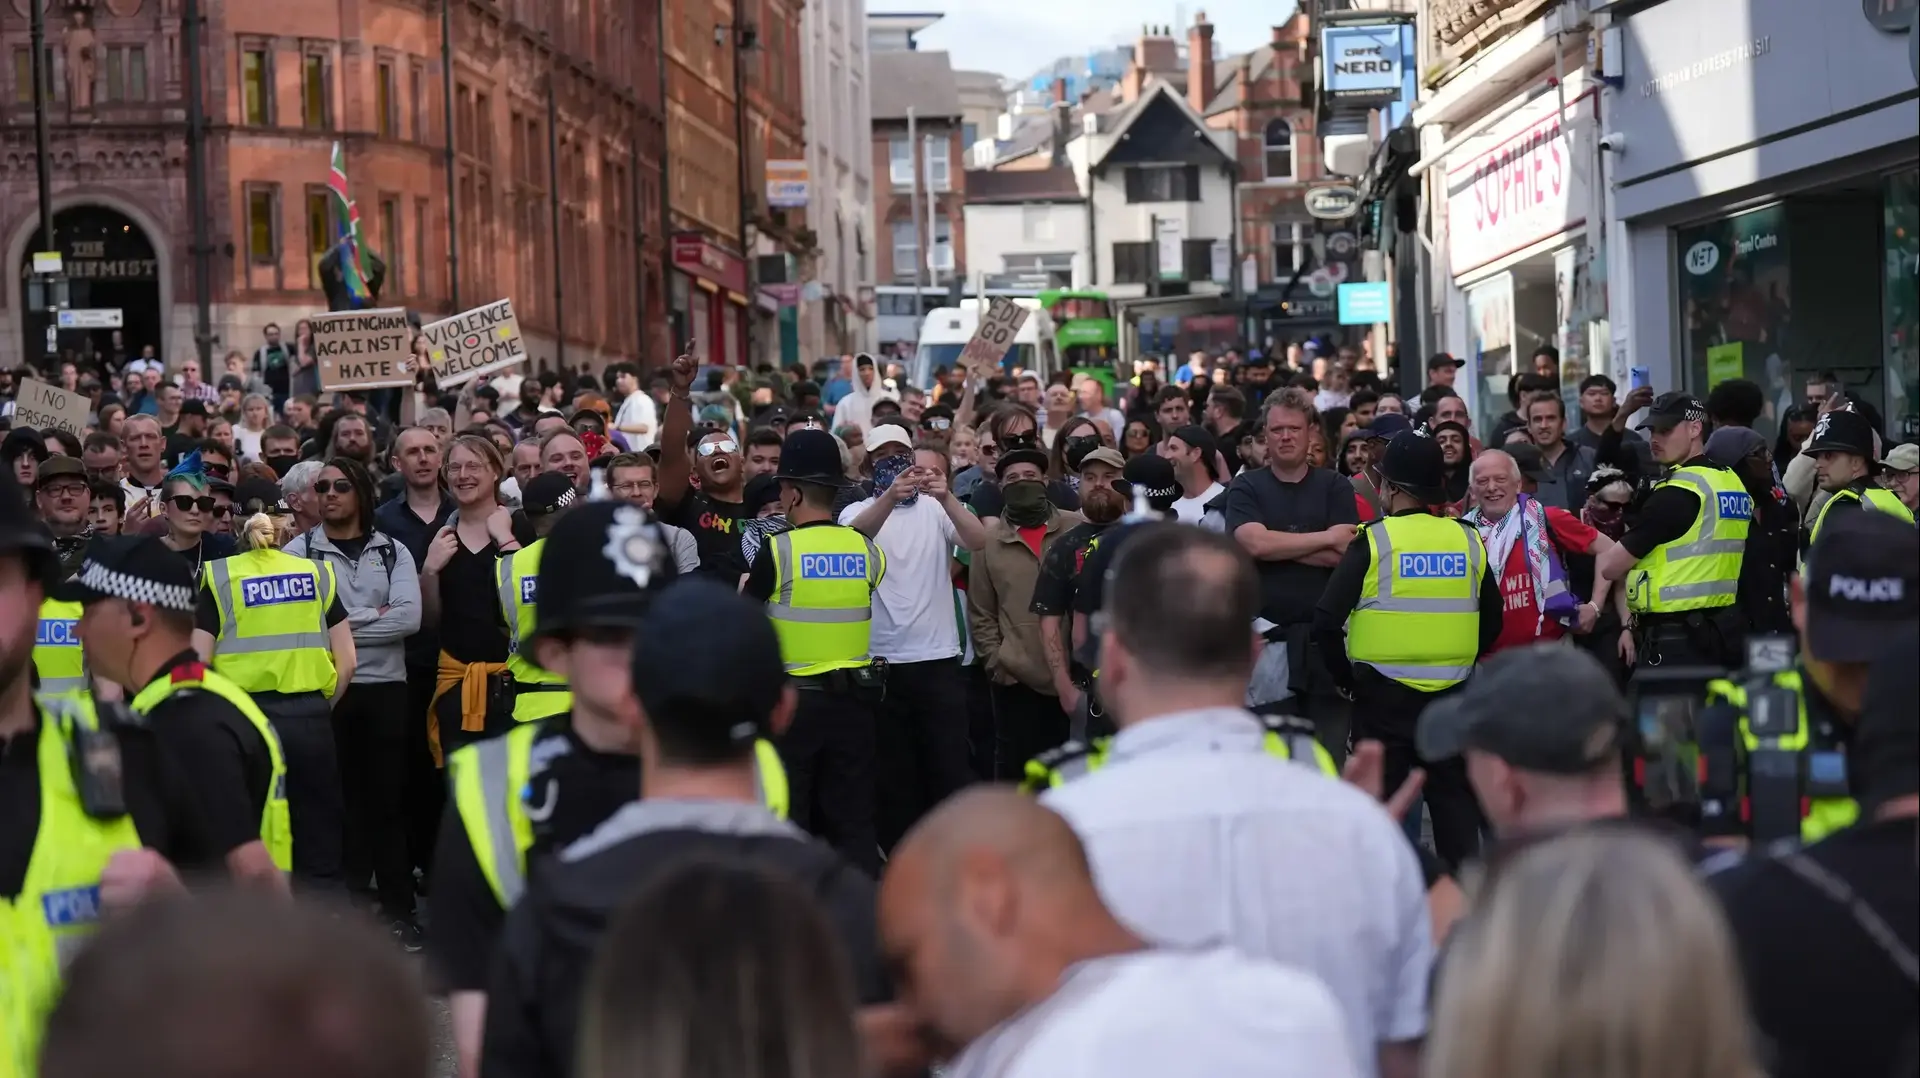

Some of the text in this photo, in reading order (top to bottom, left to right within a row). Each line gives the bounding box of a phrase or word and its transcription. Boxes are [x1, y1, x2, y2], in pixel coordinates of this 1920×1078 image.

[1334, 60, 1392, 75] NERO
[1692, 51, 1732, 80] EXPRESS
[1733, 35, 1772, 63] TRANSIT
[1474, 119, 1562, 232] SOPHIE'S
[71, 241, 104, 257] THE
[1754, 233, 1778, 251] Centre
[1691, 246, 1713, 268] NET
[23, 260, 156, 278] AHEMIST
[312, 316, 407, 333] NOTTINGHAM
[425, 302, 513, 345] VIOLENCE
[986, 297, 1022, 332] EDL
[444, 326, 497, 359] NOT
[981, 321, 1008, 344] GO
[317, 335, 403, 356] AGAINST
[433, 337, 522, 378] WELCOME
[340, 361, 391, 378] HATE
[42, 389, 66, 410] NO
[699, 512, 732, 534] GAY
[804, 555, 865, 577] POLICE
[1402, 555, 1465, 576] POLICE
[249, 576, 314, 602] POLICE
[1829, 574, 1903, 600] POLICE
